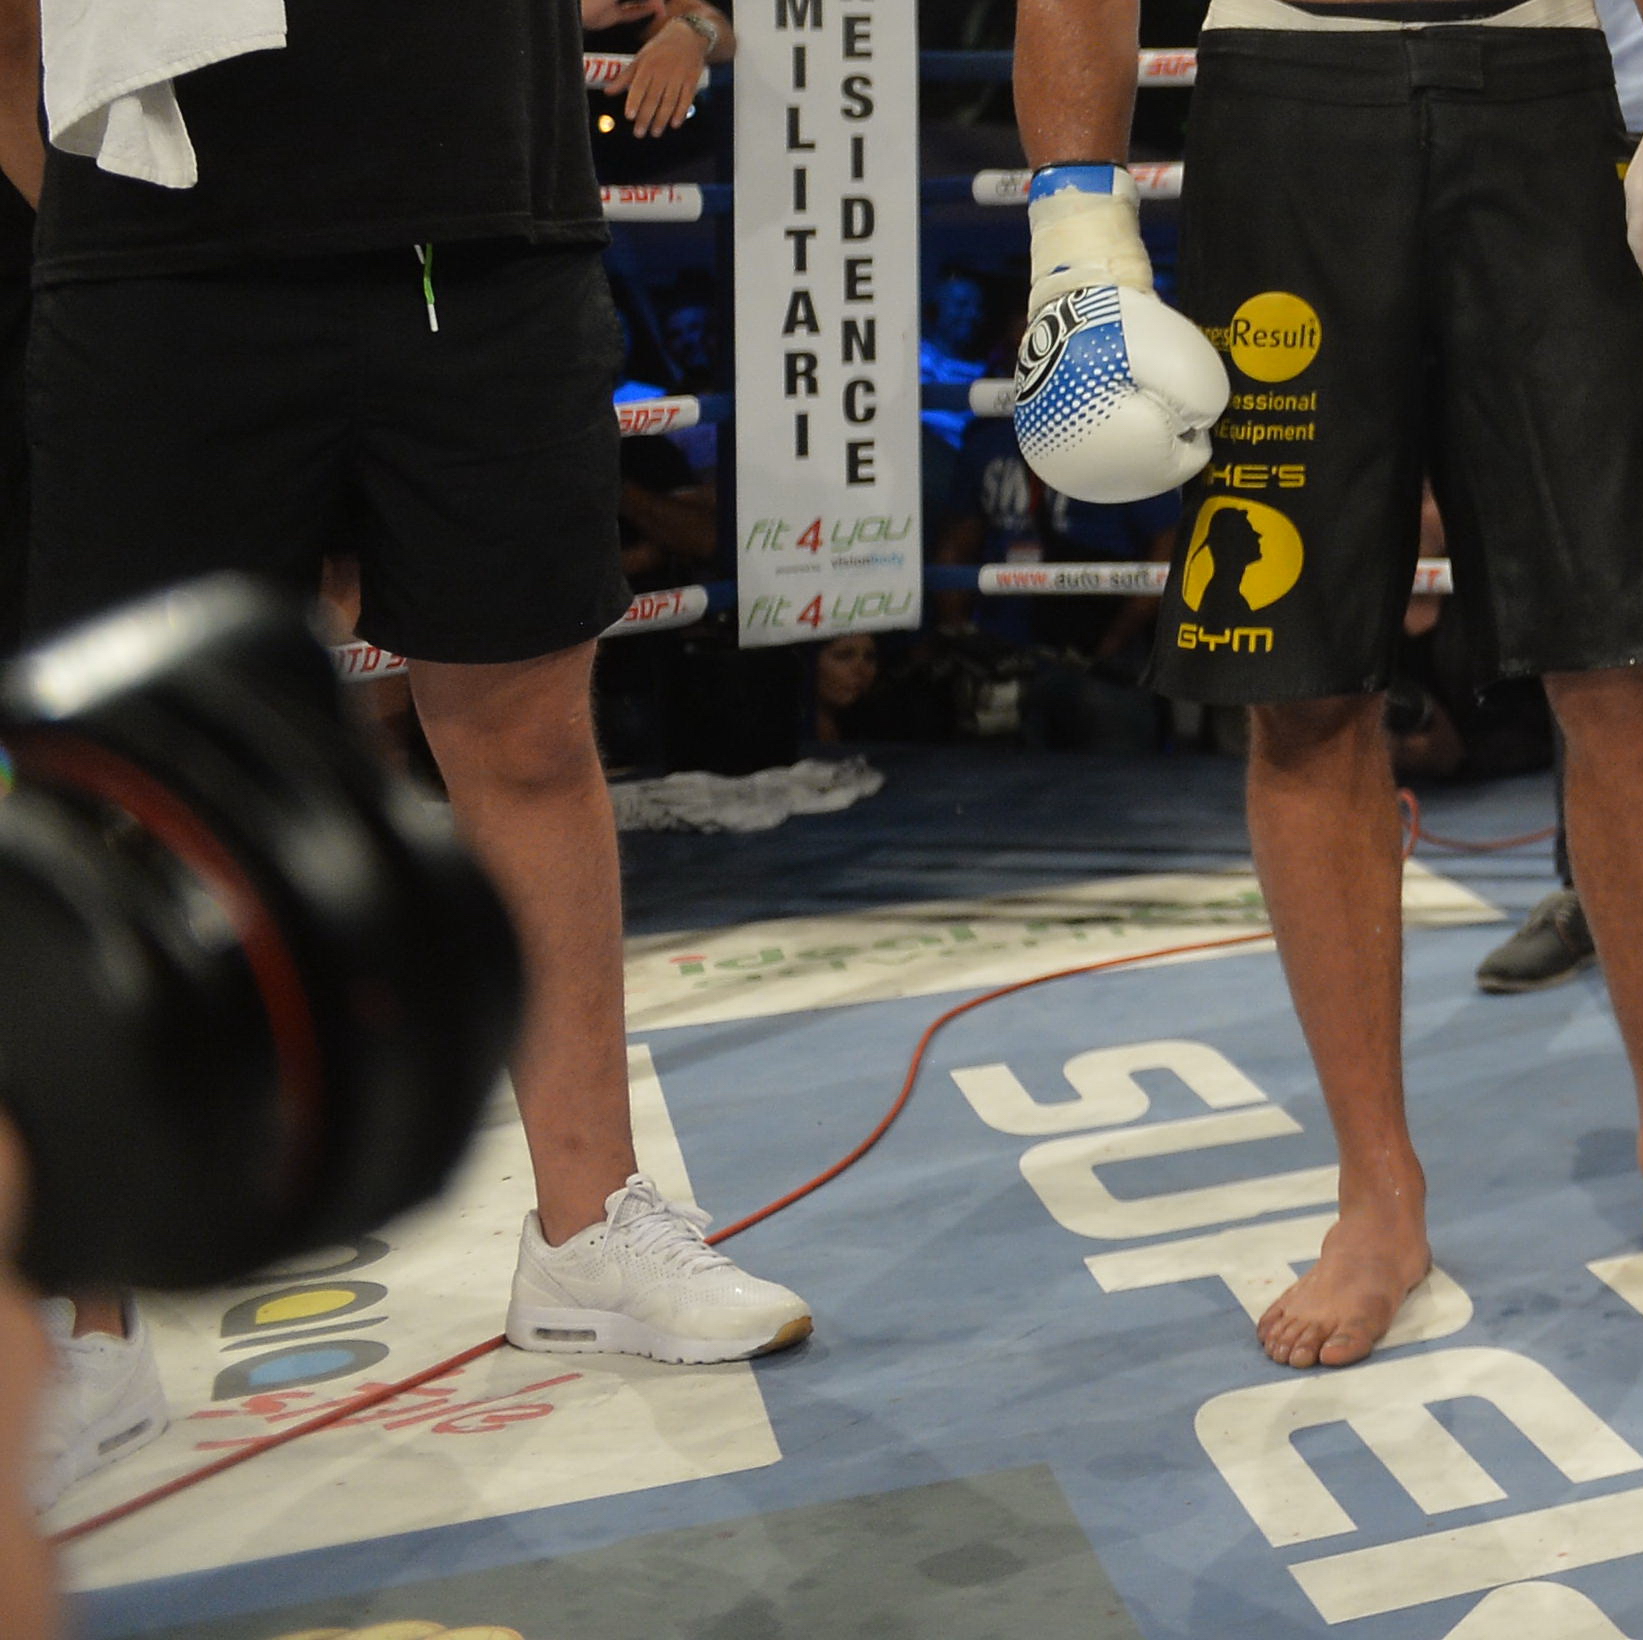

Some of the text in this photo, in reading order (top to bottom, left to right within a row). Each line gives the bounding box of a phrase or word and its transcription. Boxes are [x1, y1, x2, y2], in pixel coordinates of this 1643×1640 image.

[1232, 319, 1316, 349] Result
[797, 515, 823, 554] 4
[831, 514, 912, 554] you
[797, 593, 823, 630] 4
[831, 592, 912, 629] you
[1177, 623, 1274, 653] GYM
